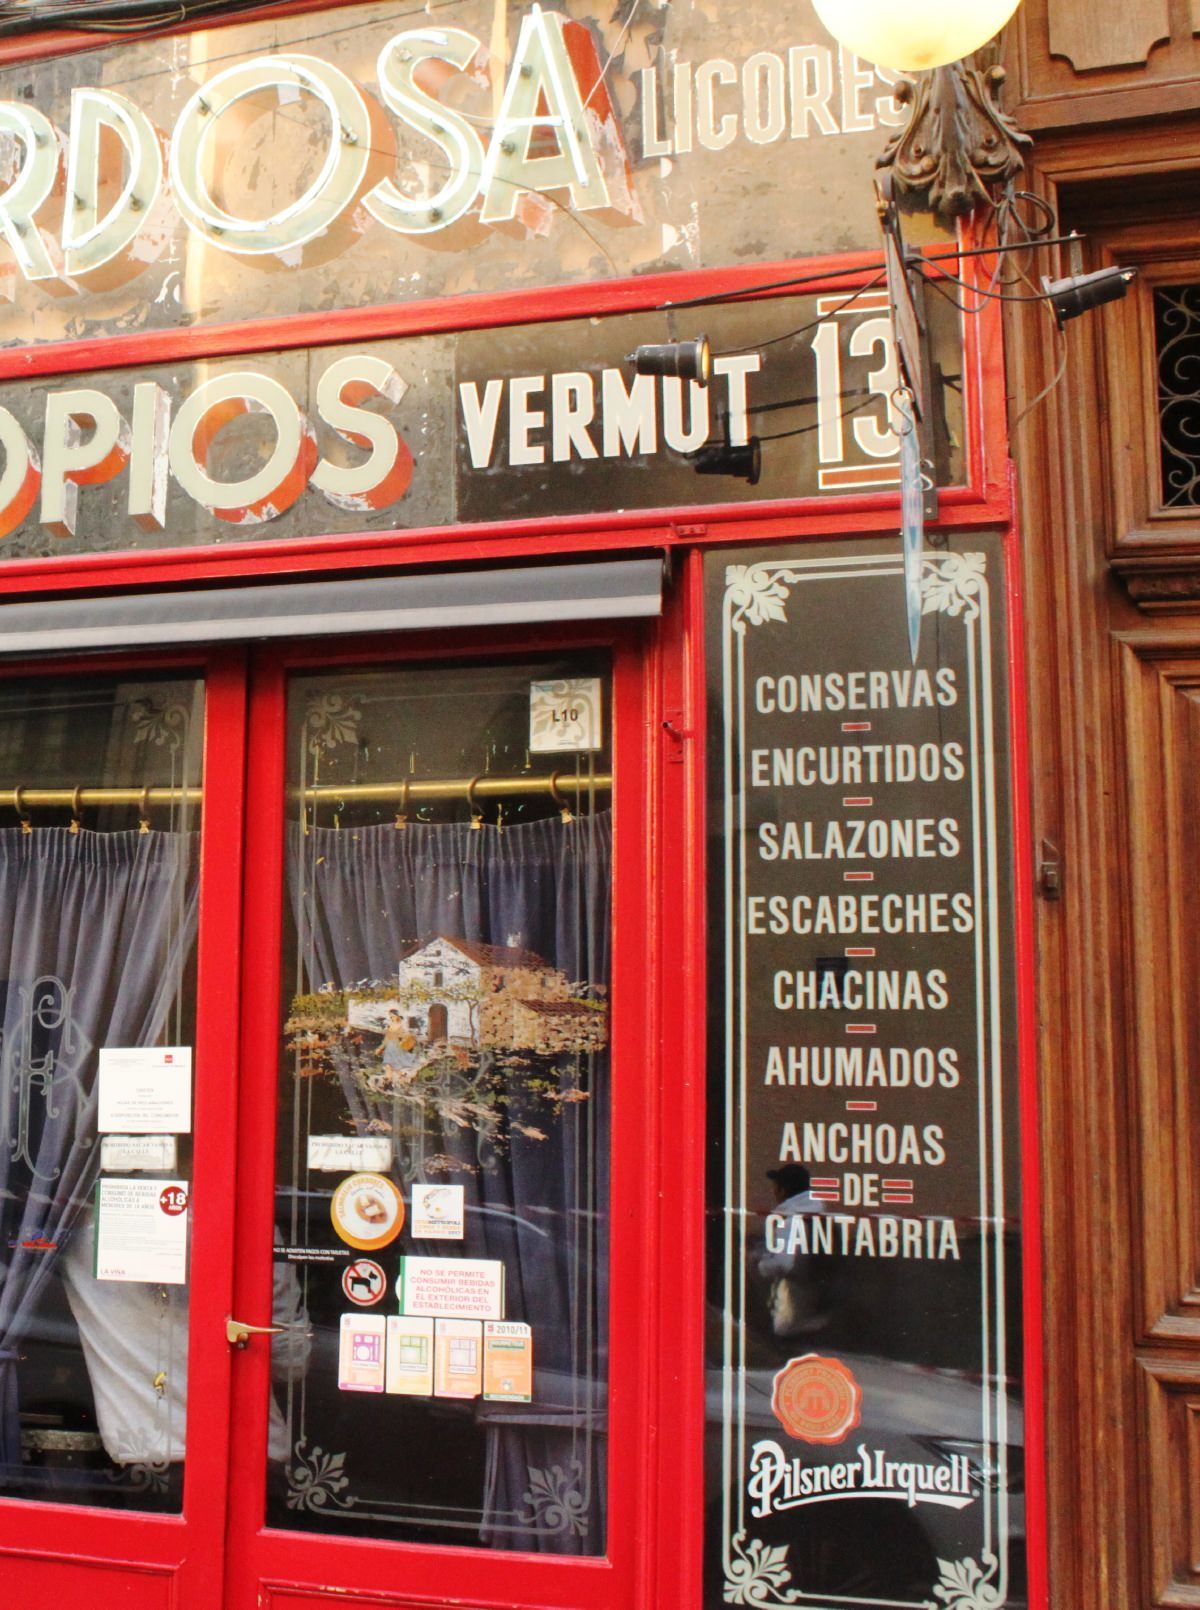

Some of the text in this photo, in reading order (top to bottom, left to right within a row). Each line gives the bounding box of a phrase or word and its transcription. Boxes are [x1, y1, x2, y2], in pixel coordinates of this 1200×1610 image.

[642, 42, 916, 158] LICORES
[460, 353, 762, 469] VERMUT
[810, 317, 906, 463] 13
[755, 667, 958, 714] CONSERVAS
[752, 742, 965, 787] ENCURTIDOS
[758, 818, 961, 861] SALAZONES
[747, 892, 975, 935] ESCABECHES
[773, 968, 950, 1011] CHACINAS
[764, 1046, 961, 1088] AHUMADOS
[779, 1122, 946, 1166] ANCHOAS
[160, 1191, 187, 1205] +18
[843, 1172, 880, 1207] DE
[764, 1213, 961, 1260] CANTABRIA
[447, 1270, 486, 1278] PERMITE
[412, 1301, 492, 1312] ESTABLECIMIENTO
[748, 1439, 971, 1518] Pilsner Urquell
